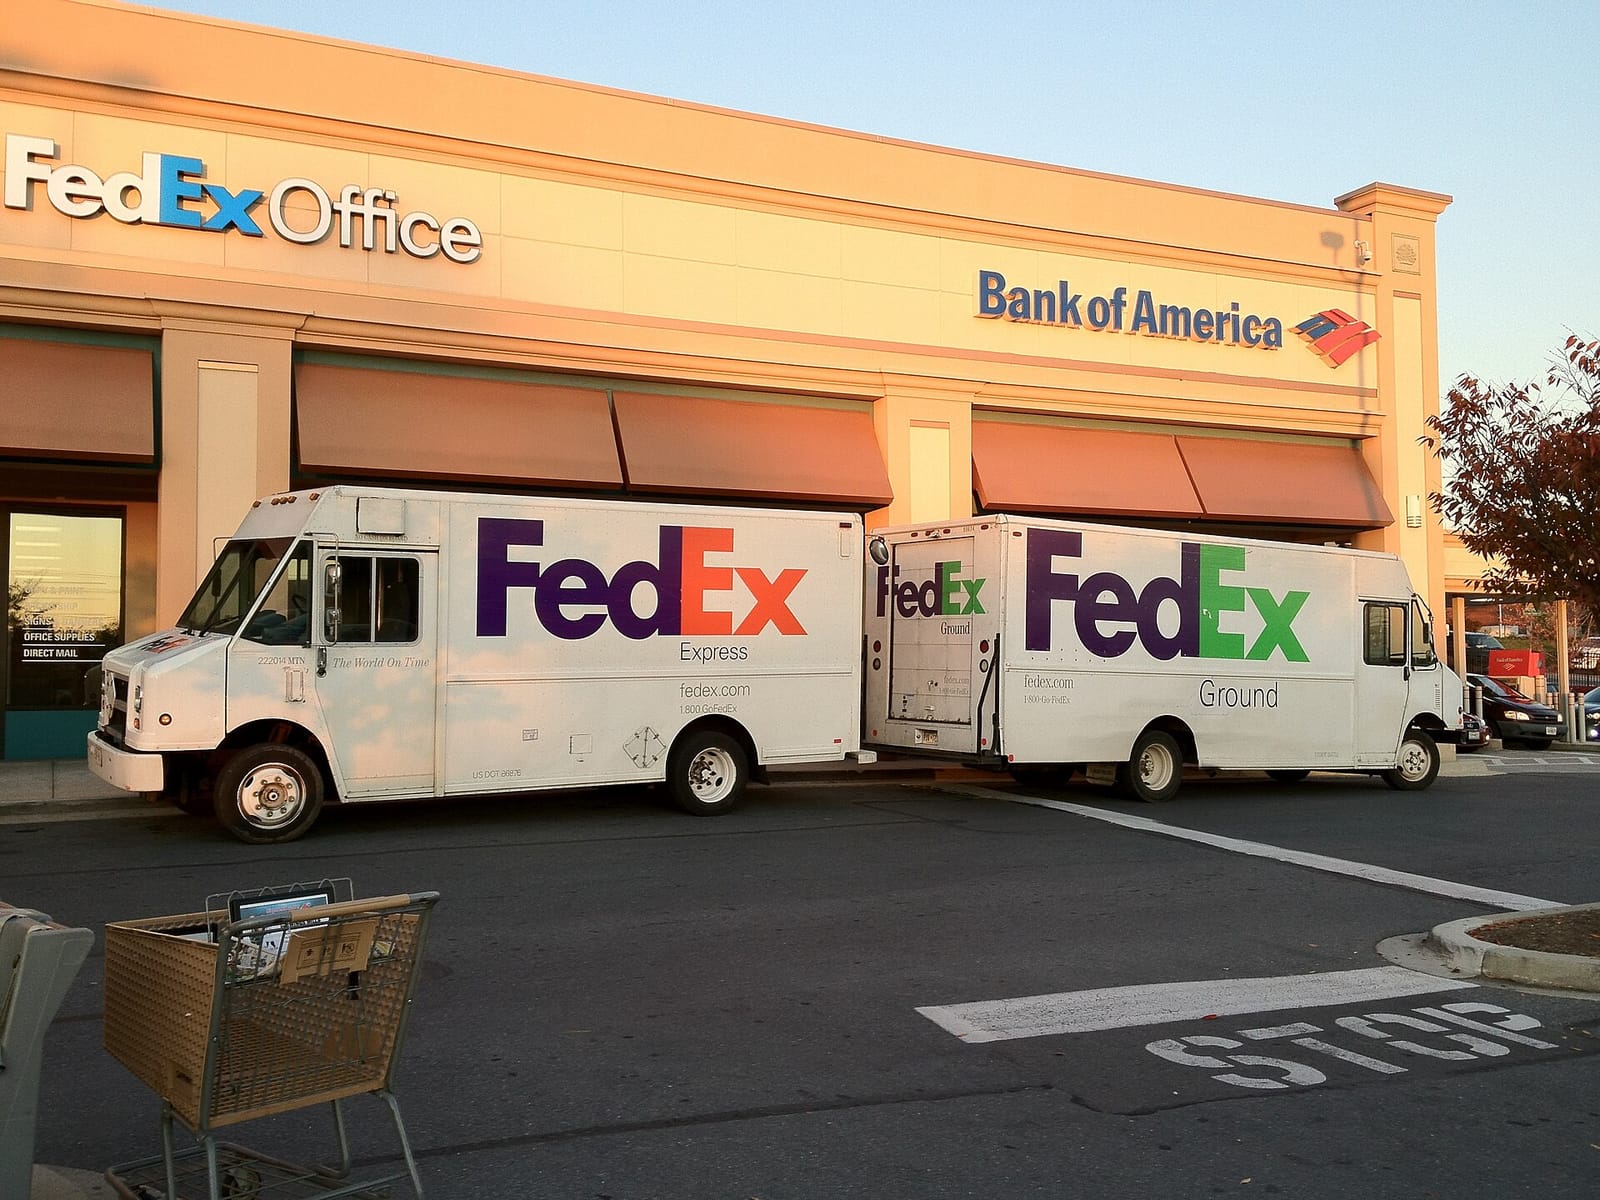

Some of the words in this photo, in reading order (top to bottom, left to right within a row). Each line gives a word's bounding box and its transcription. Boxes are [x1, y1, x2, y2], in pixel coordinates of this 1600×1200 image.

[4, 133, 265, 237] FedEx
[268, 178, 482, 263] Office
[978, 269, 1083, 327] Bank
[1086, 286, 1127, 331] of
[1130, 289, 1283, 349] America
[476, 516, 809, 640] FedEx
[876, 560, 987, 619] FedEx
[1025, 526, 1311, 663] FedEx
[24, 617, 51, 626] SIGNS
[940, 620, 971, 636] Ground
[24, 632, 53, 641] OFFICE
[54, 632, 96, 642] SUPPLIES
[23, 648, 54, 657] DIRECT
[55, 649, 79, 658] MAIL
[332, 656, 352, 668] The
[354, 657, 385, 668] World
[387, 657, 401, 668] On
[404, 656, 430, 668] Time
[680, 641, 749, 665] Express
[679, 682, 751, 698] fedex.com
[1023, 673, 1075, 689] fedex.com
[1199, 678, 1279, 709] Ground
[472, 770, 484, 779] US
[484, 769, 499, 779] DOT
[1144, 1001, 1560, 1090] STOP
